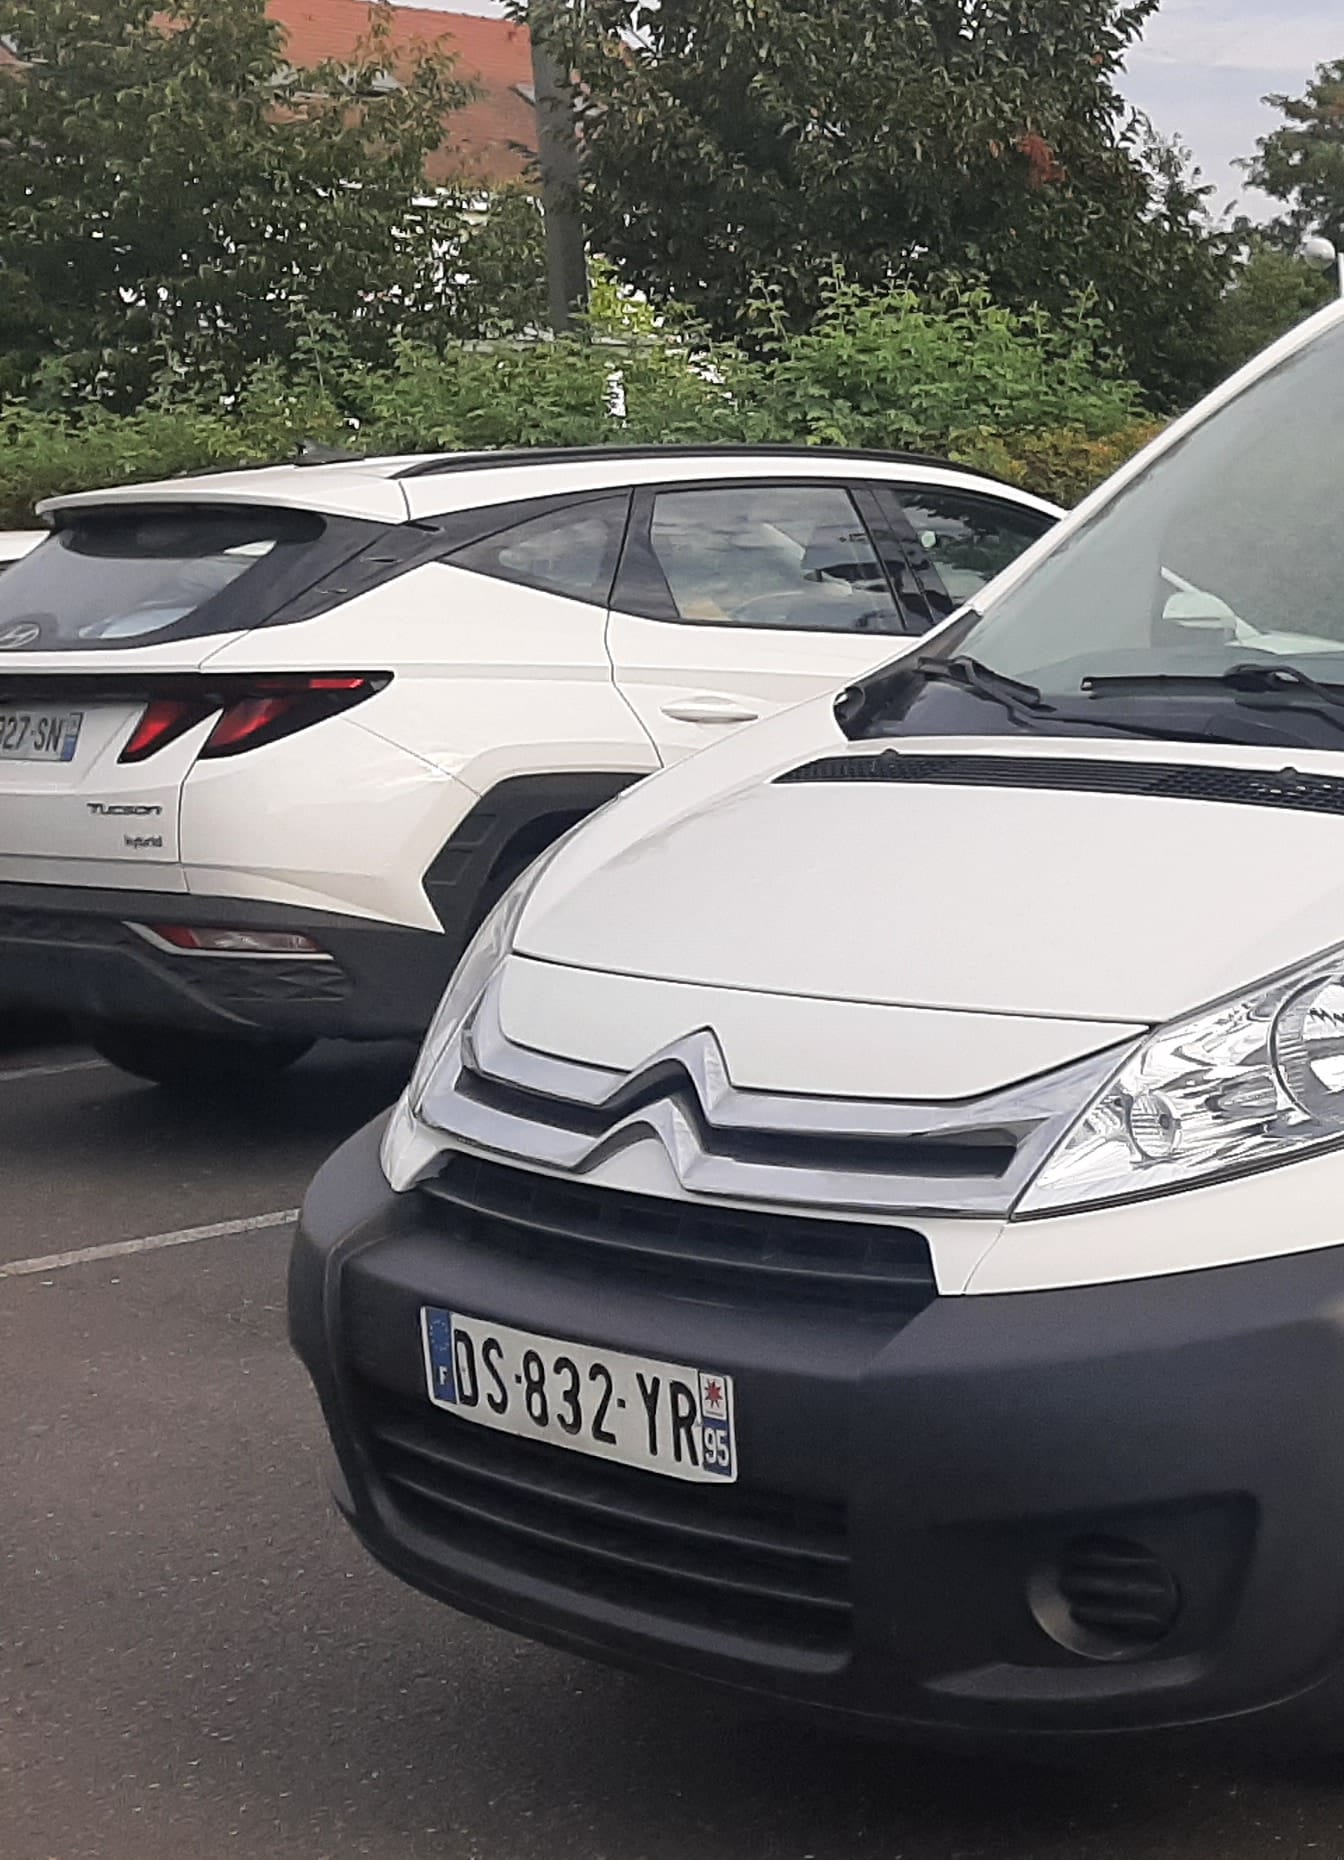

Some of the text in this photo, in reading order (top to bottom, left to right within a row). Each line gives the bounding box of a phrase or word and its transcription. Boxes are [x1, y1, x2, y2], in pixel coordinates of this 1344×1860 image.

[439, 1366, 448, 1385] F
[454, 1328, 699, 1466] DS-832-YR
[704, 1427, 729, 1467] 95
